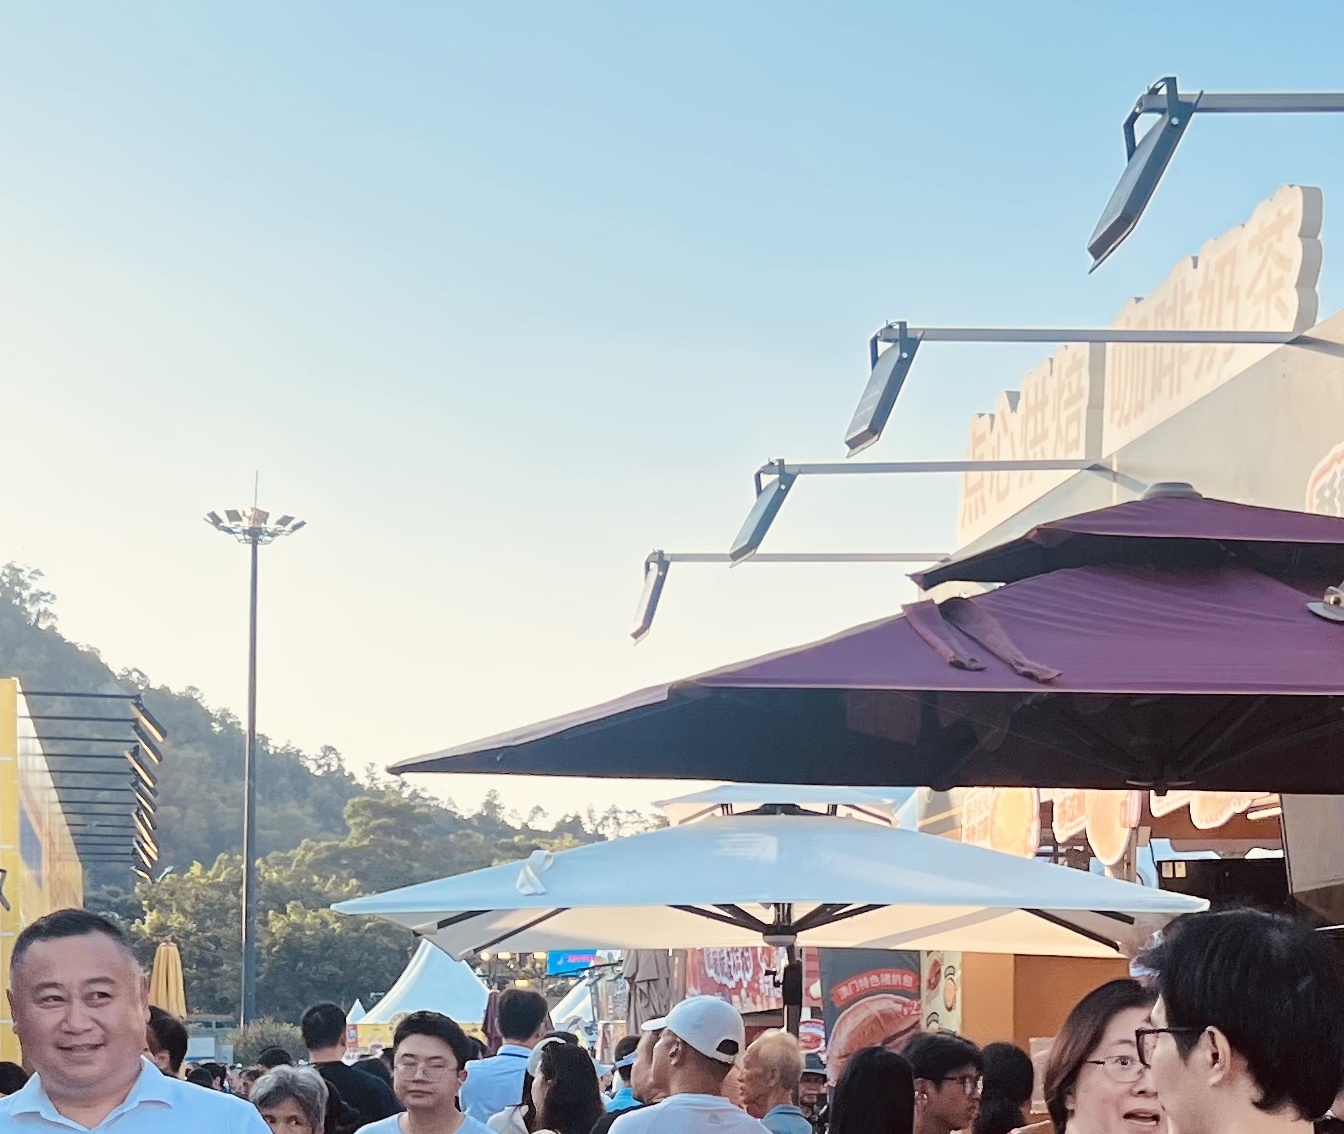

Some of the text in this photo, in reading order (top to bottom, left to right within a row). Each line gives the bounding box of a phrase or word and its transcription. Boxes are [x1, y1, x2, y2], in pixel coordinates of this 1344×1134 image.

[1108, 208, 1295, 429] 咖啡奶茶
[960, 352, 1085, 529] 点心烘焙
